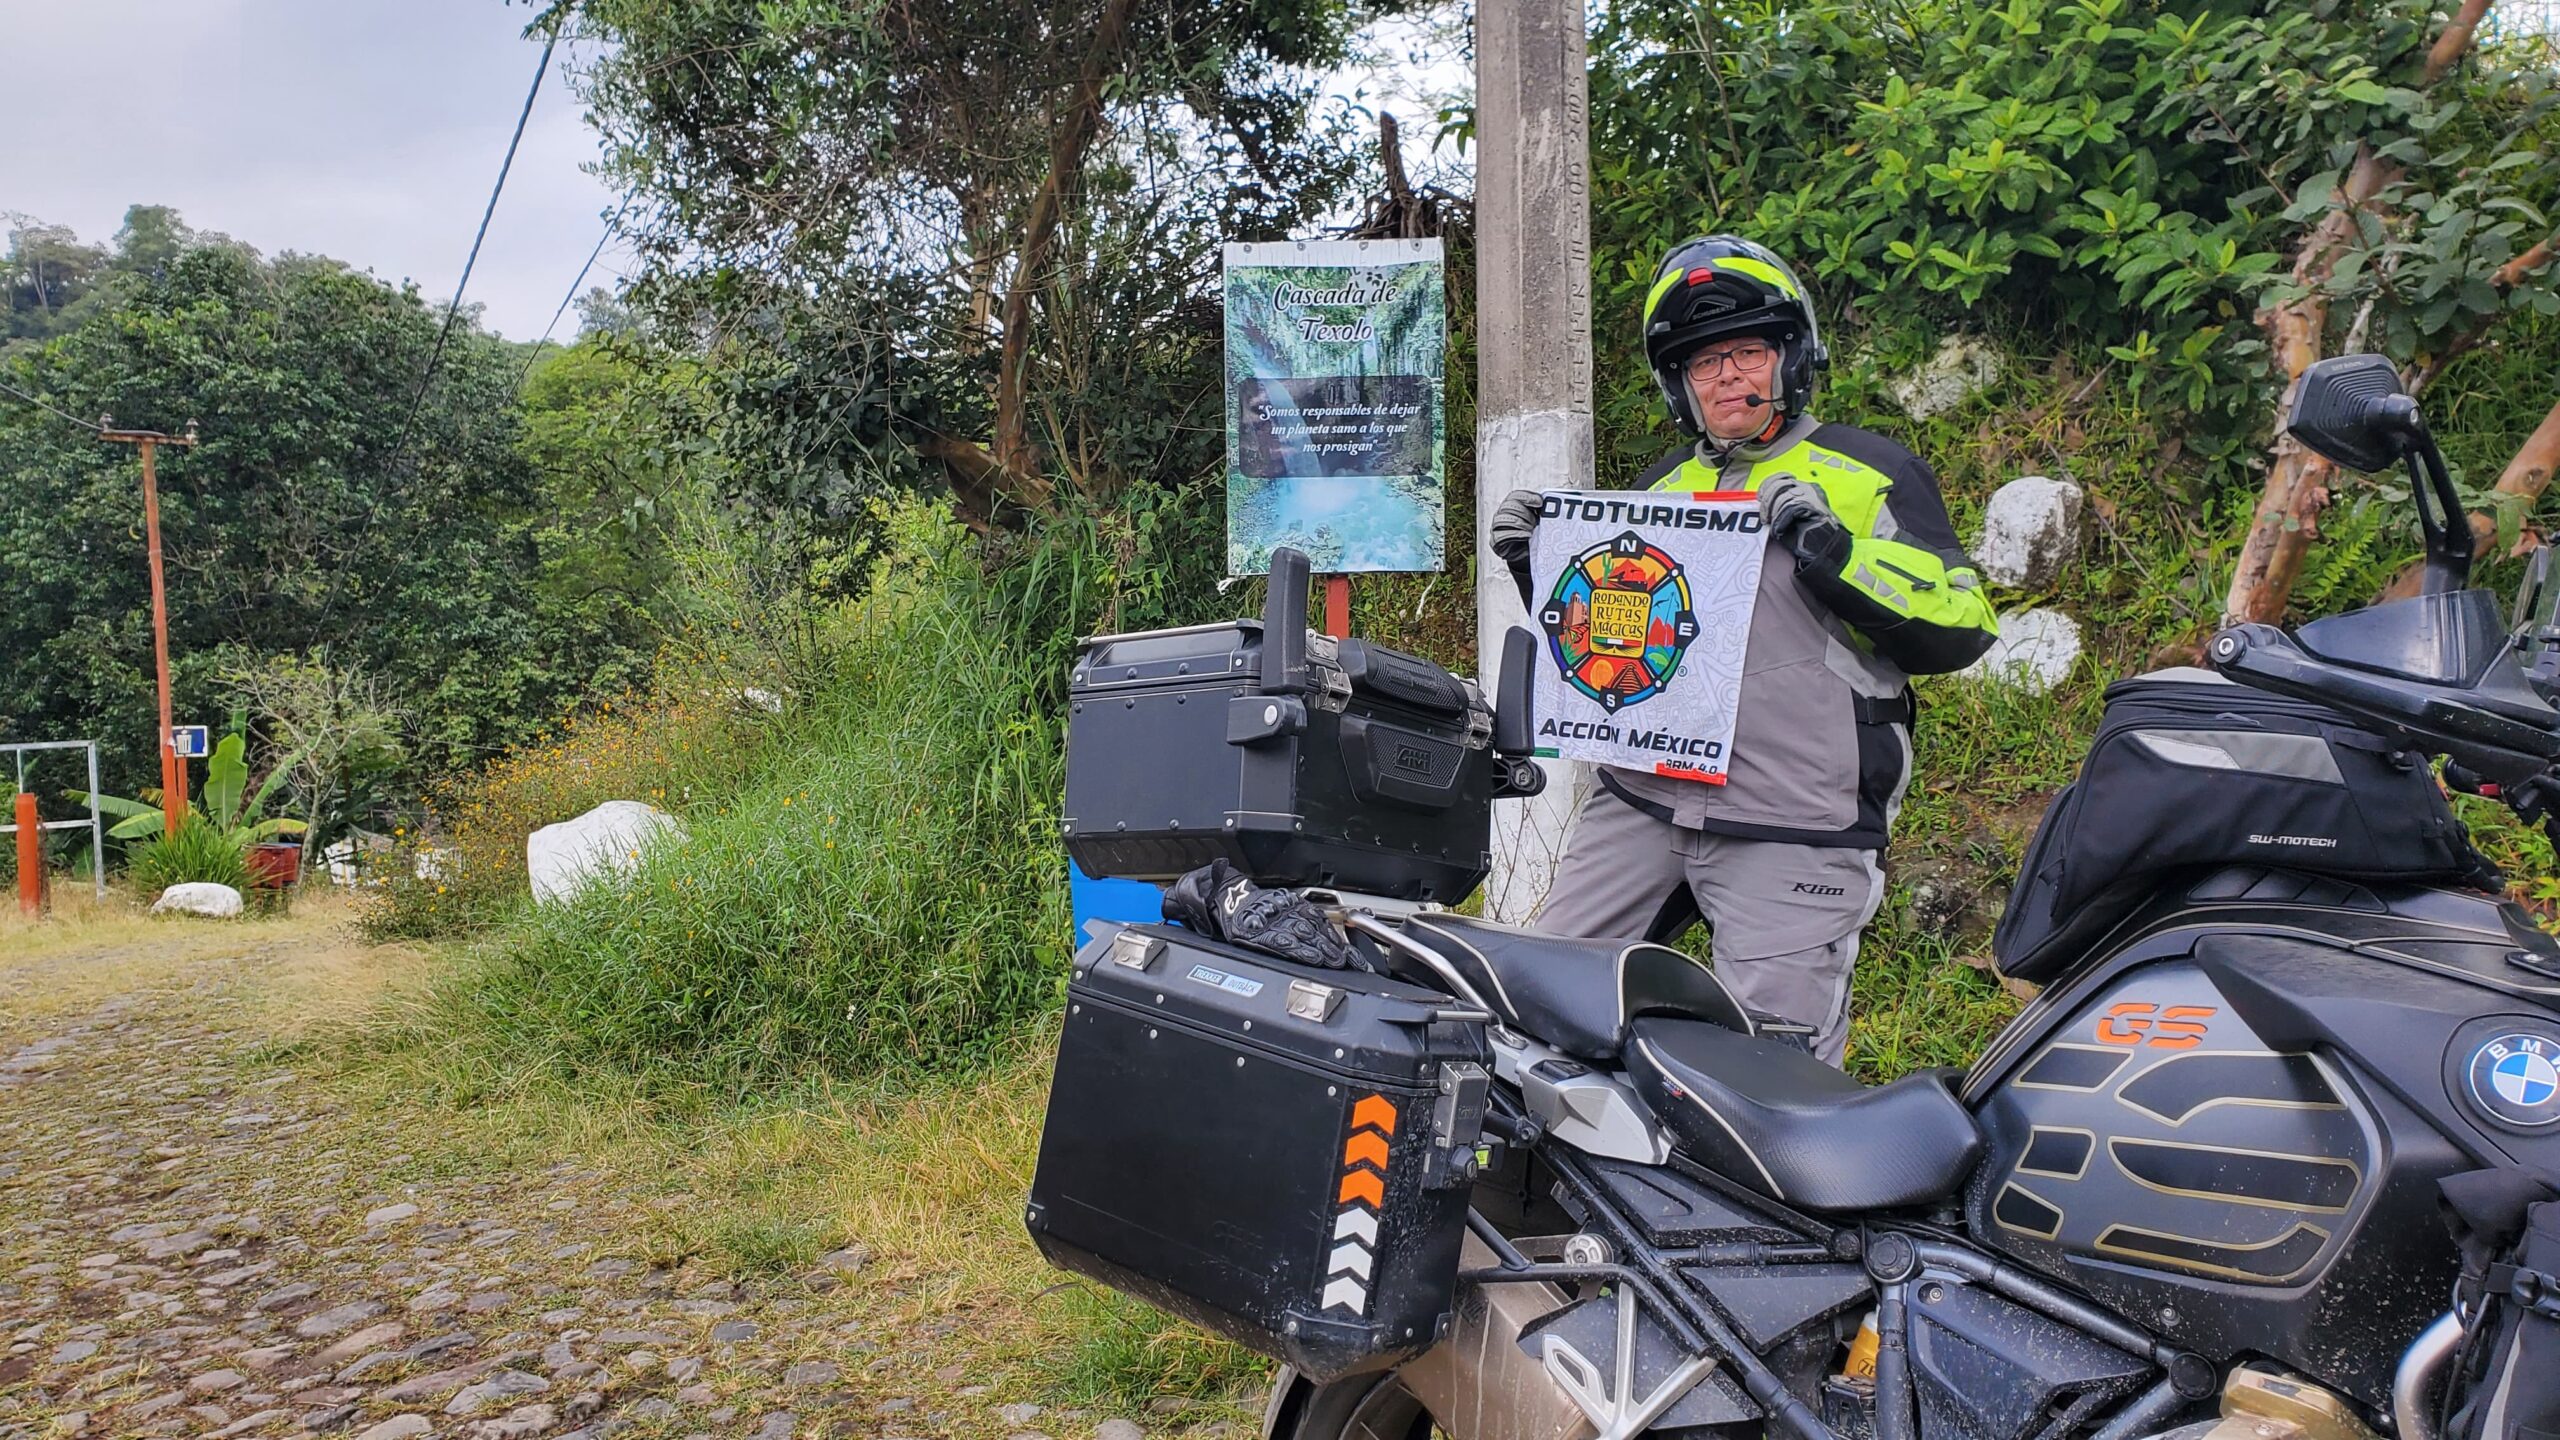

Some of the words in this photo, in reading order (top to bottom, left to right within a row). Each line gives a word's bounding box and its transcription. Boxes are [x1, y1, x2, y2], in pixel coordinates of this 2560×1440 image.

[1274, 281, 1364, 312] Cascada
[1372, 281, 1397, 303] de
[1299, 316, 1373, 341] Texolo
[1302, 403, 1371, 420] responsables
[1374, 403, 1388, 415] de
[1389, 403, 1421, 418] dejar
[1271, 426, 1286, 435] un
[1286, 422, 1329, 438] planeta
[1331, 424, 1358, 434] sano
[1359, 425, 1367, 434] a
[1369, 422, 1384, 433] los
[1386, 424, 1408, 437] que
[1302, 443, 1322, 452] nos
[1540, 496, 1763, 534] OTOTURISMO
[1619, 539, 1637, 553] N
[1544, 610, 1561, 624] O
[1678, 622, 1694, 637] E
[1606, 694, 1616, 707] S
[1539, 718, 1620, 744] ACCIÓN
[1627, 727, 1723, 760] MÉXICO
[1698, 763, 1718, 775] 4.0
[2248, 834, 2337, 848] SW-MOTECH
[2096, 1002, 2218, 1050] GS
